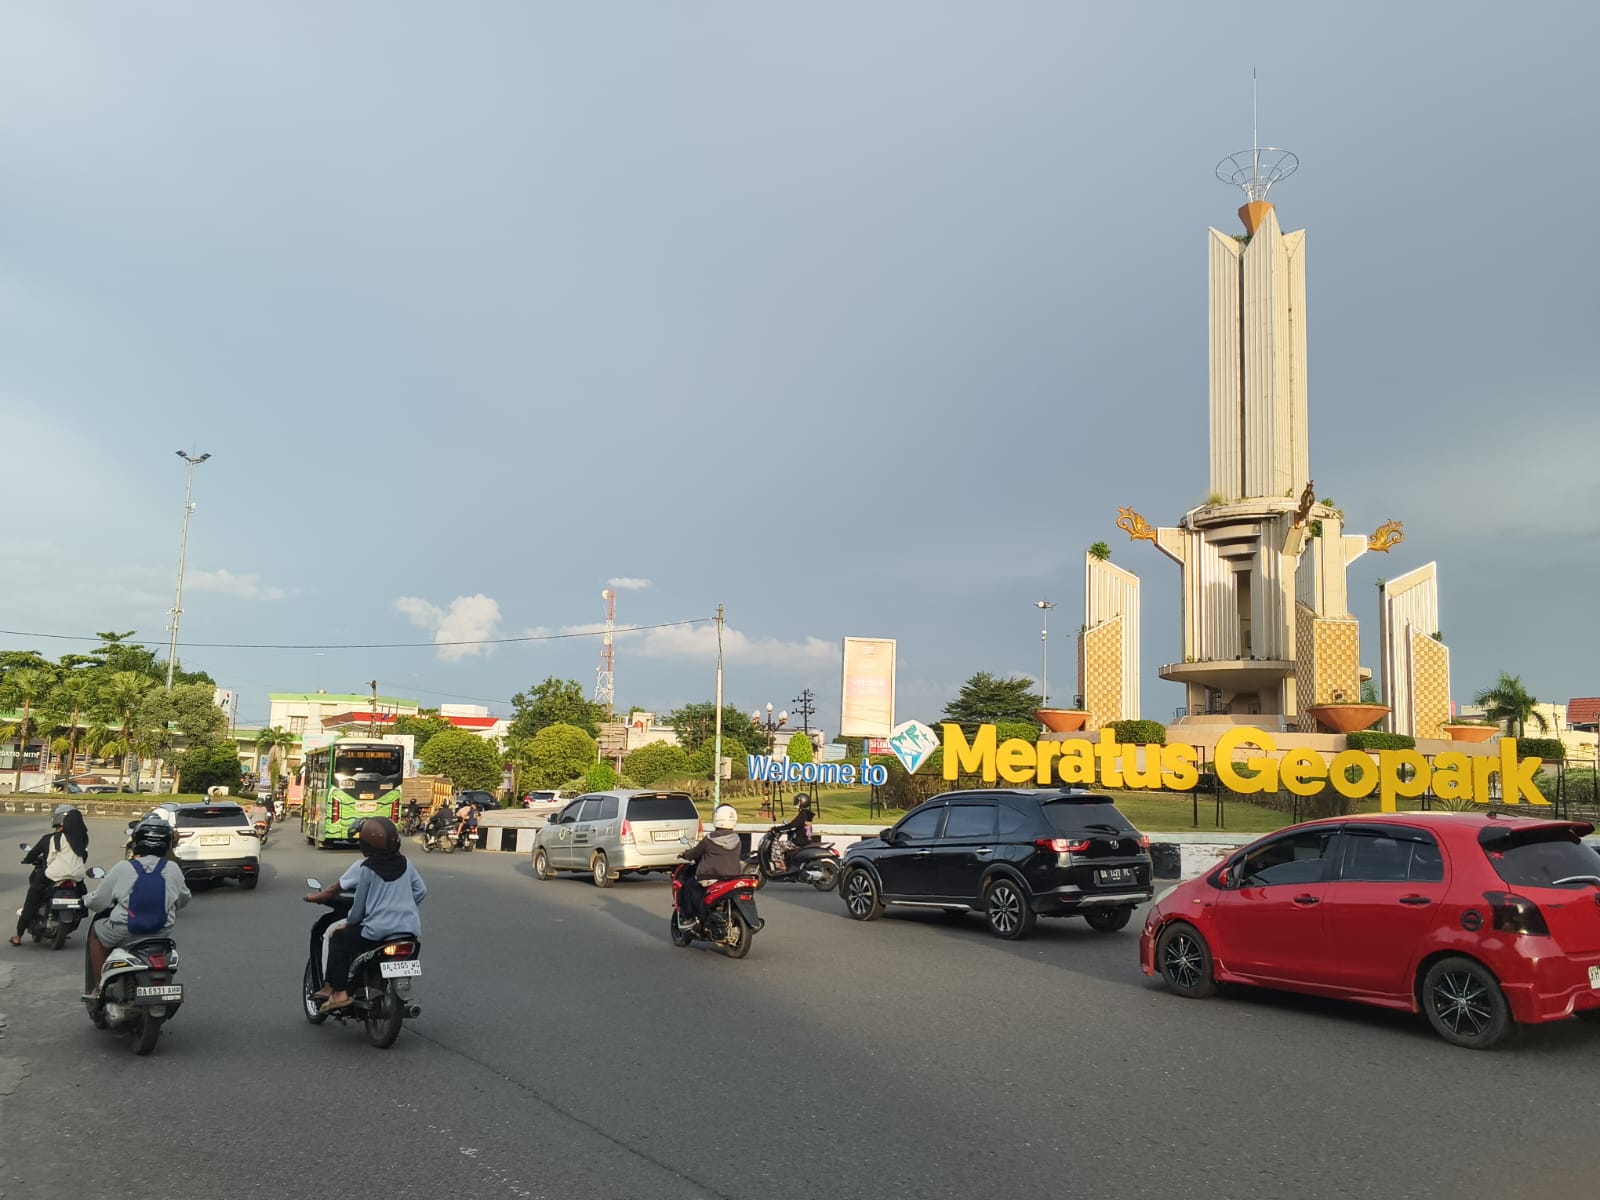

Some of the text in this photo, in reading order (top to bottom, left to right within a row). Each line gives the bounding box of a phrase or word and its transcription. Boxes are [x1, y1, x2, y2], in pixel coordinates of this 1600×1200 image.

[747, 754, 888, 786] Welcome to
[941, 723, 1551, 813] Meratus Geopark
[382, 963, 390, 971] DA
